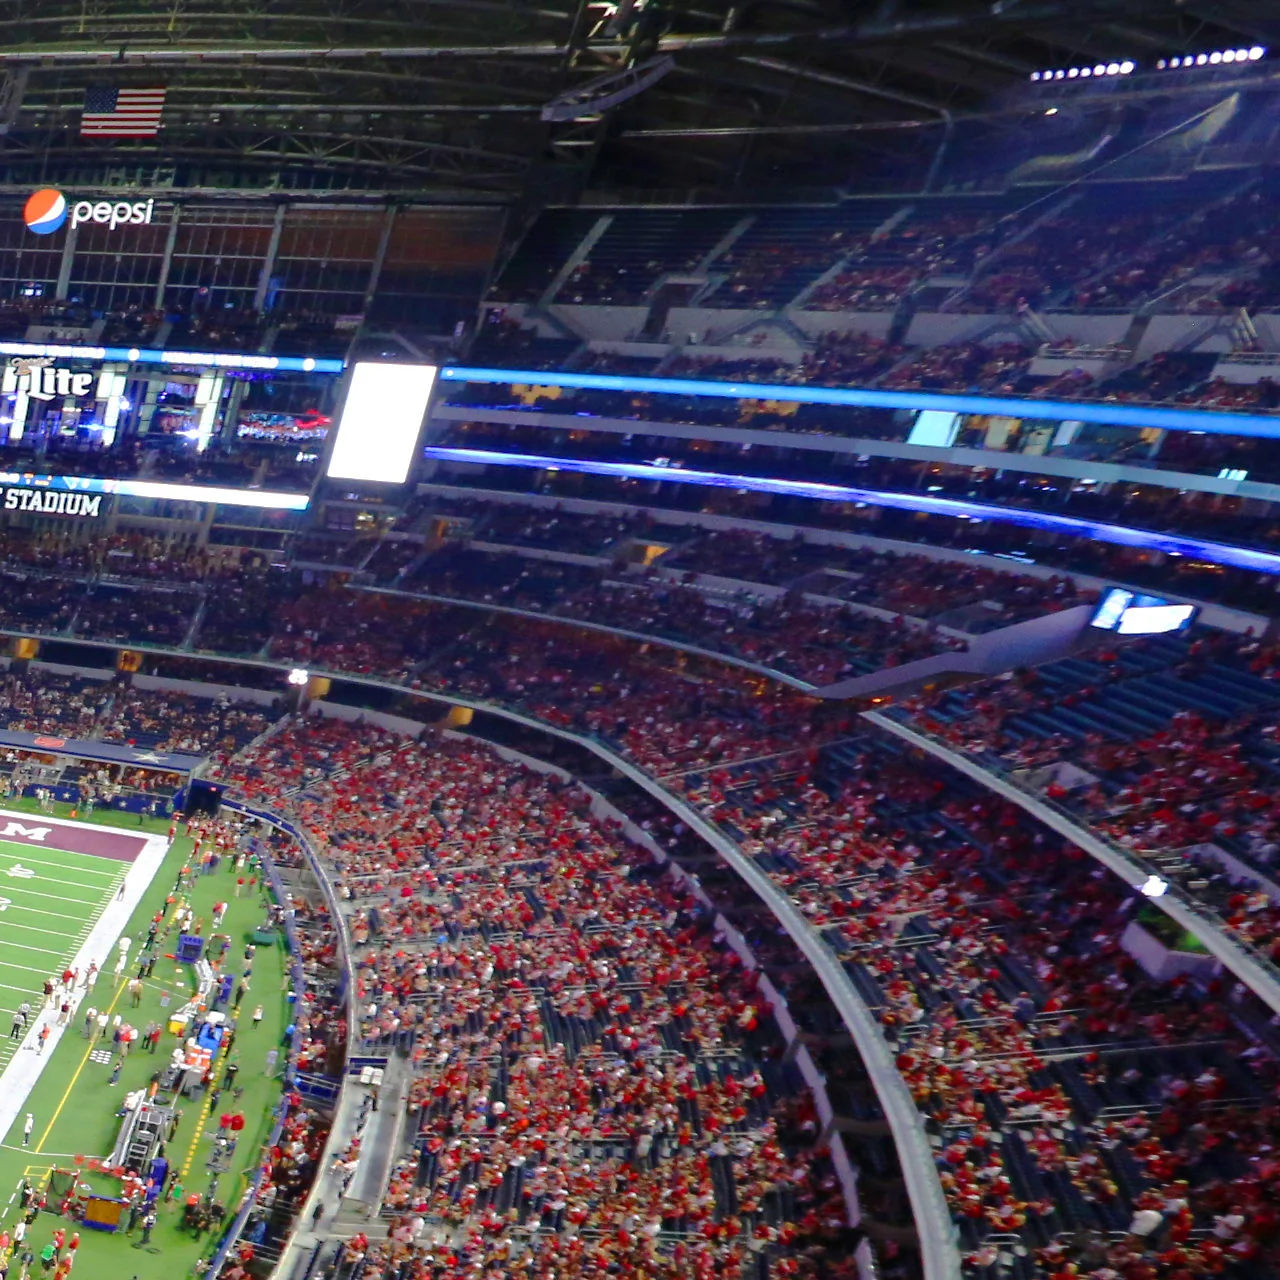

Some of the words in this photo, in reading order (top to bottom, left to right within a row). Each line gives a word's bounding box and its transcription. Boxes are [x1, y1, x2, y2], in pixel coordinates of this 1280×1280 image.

[71, 198, 154, 230] pepsi
[25, 365, 93, 400] Lite
[4, 488, 102, 517] STADIUM
